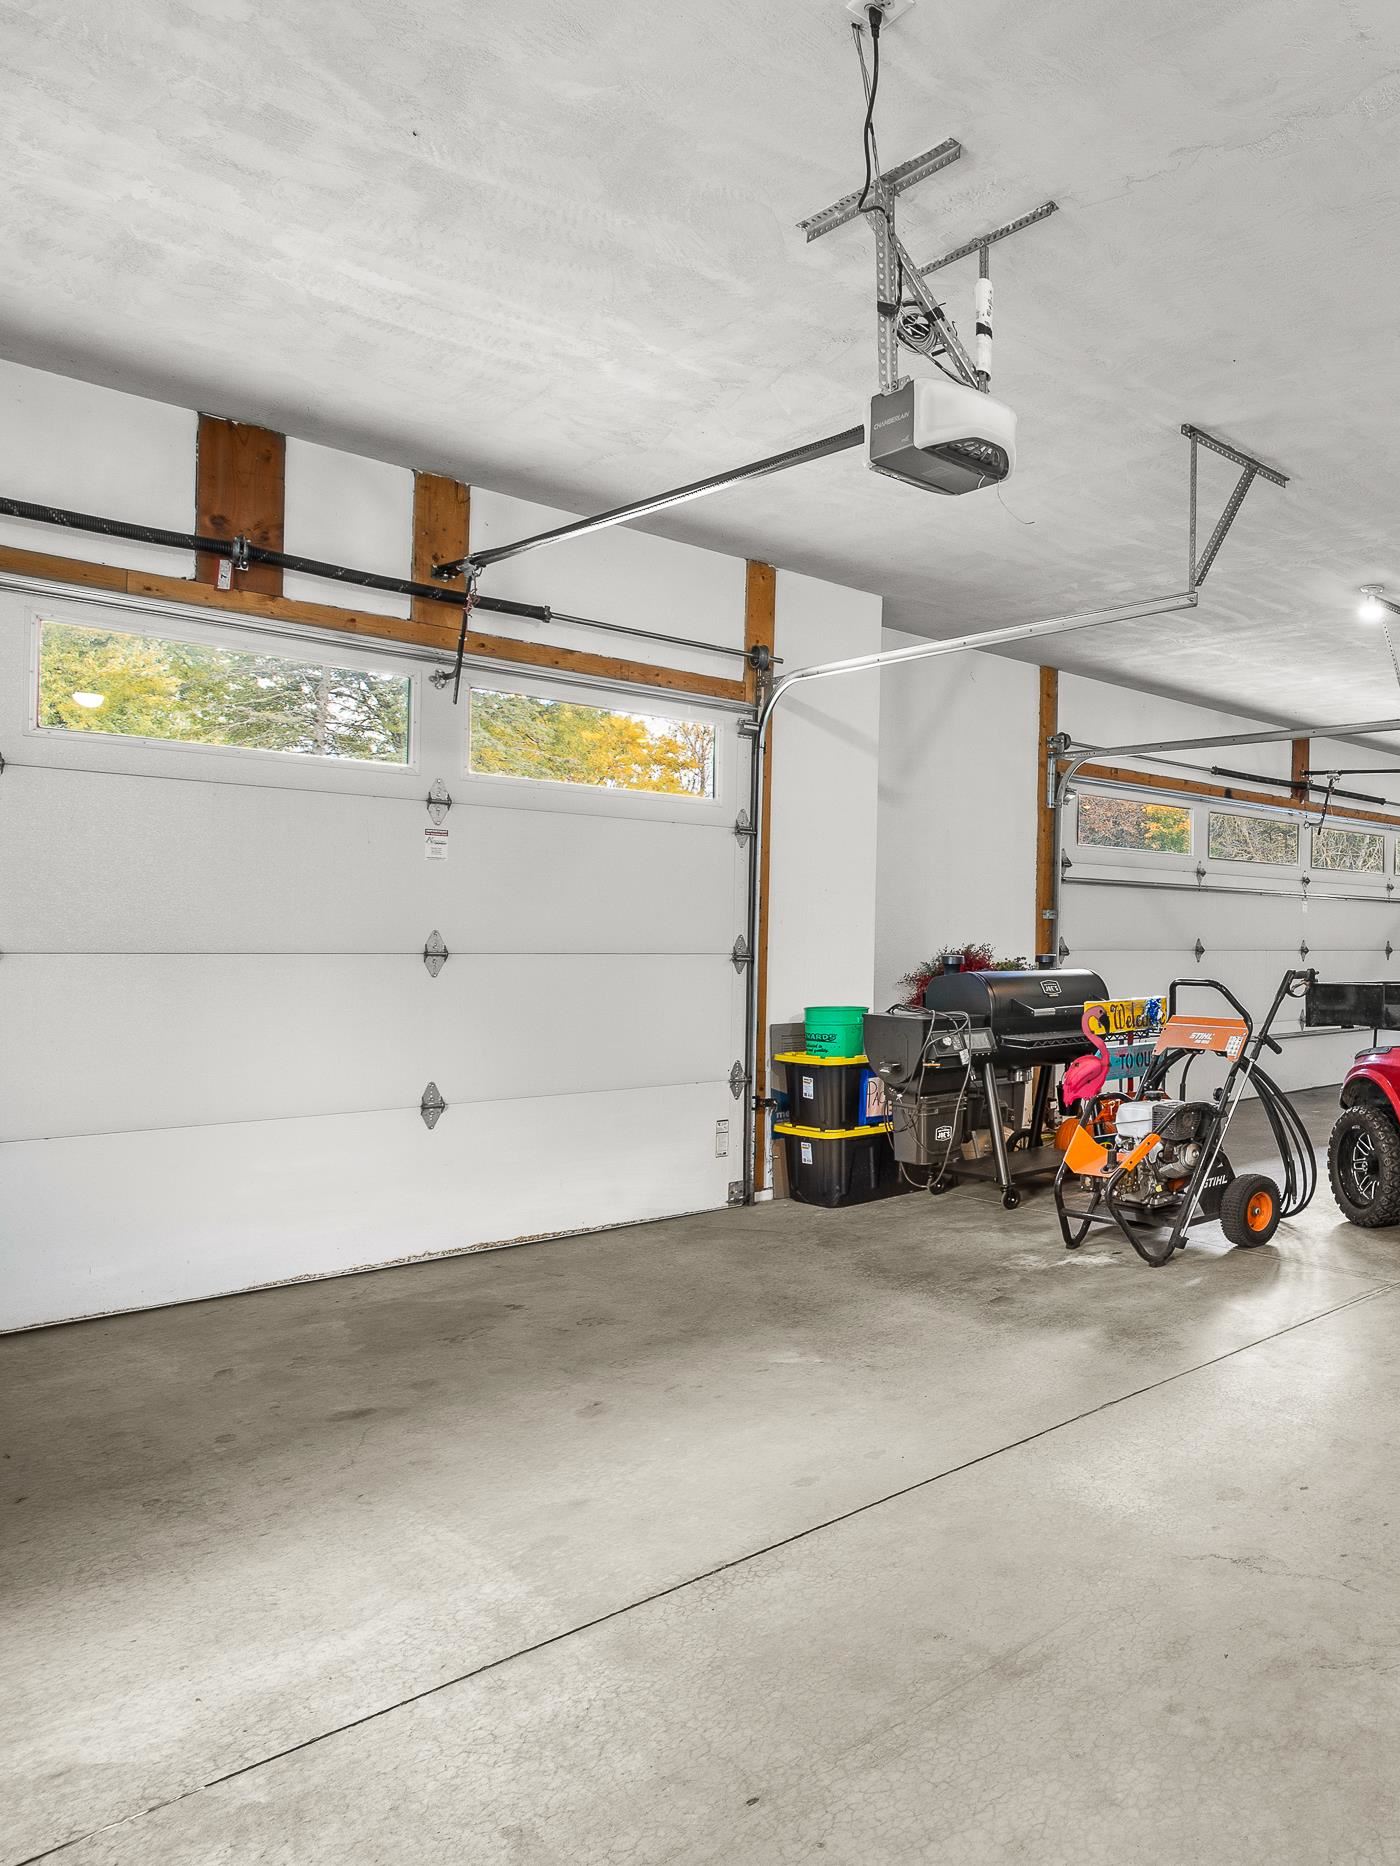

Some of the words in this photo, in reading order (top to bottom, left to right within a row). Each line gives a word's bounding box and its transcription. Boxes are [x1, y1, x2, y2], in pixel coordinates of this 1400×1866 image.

[1189, 1032, 1213, 1040] STIHL
[1120, 1052, 1134, 1069] TO
[1203, 1174, 1228, 1189] STIHL
